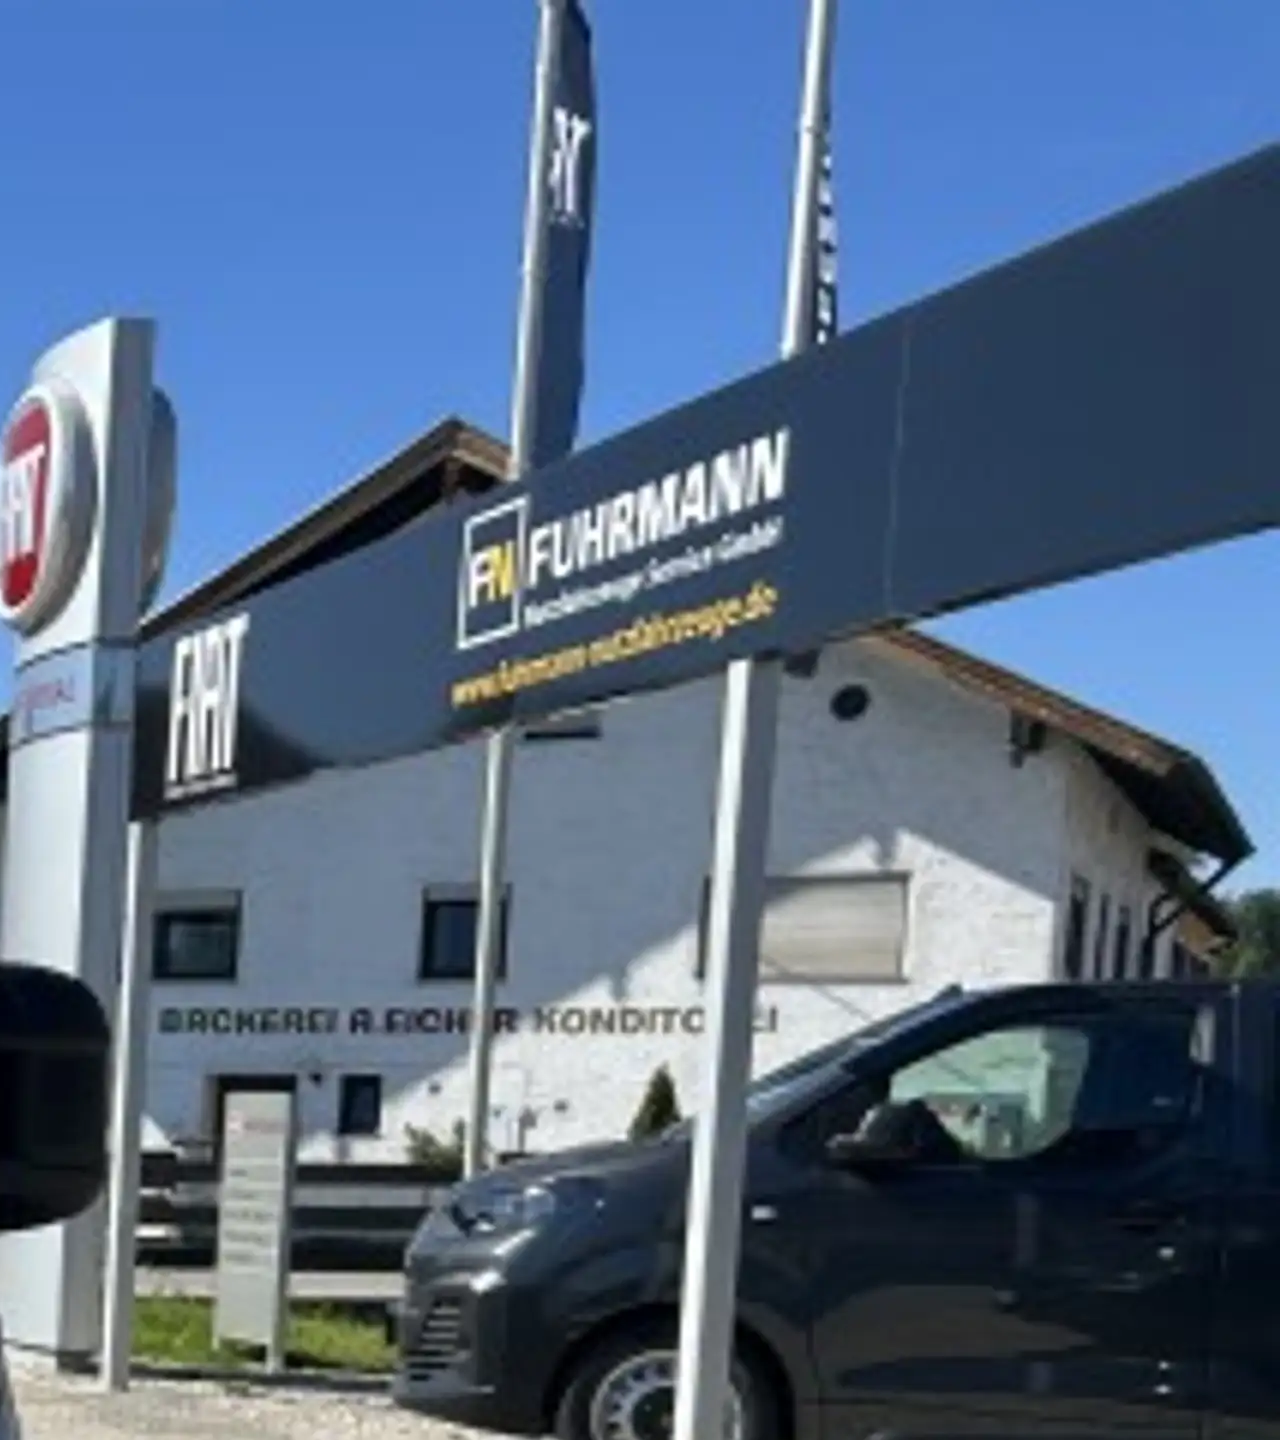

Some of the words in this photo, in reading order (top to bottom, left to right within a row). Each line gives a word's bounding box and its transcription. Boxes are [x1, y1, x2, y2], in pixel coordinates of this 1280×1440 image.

[528, 427, 788, 588] FUHRMANN
[168, 613, 250, 784] FIAT
[534, 1007, 778, 1034] KONDITOI
